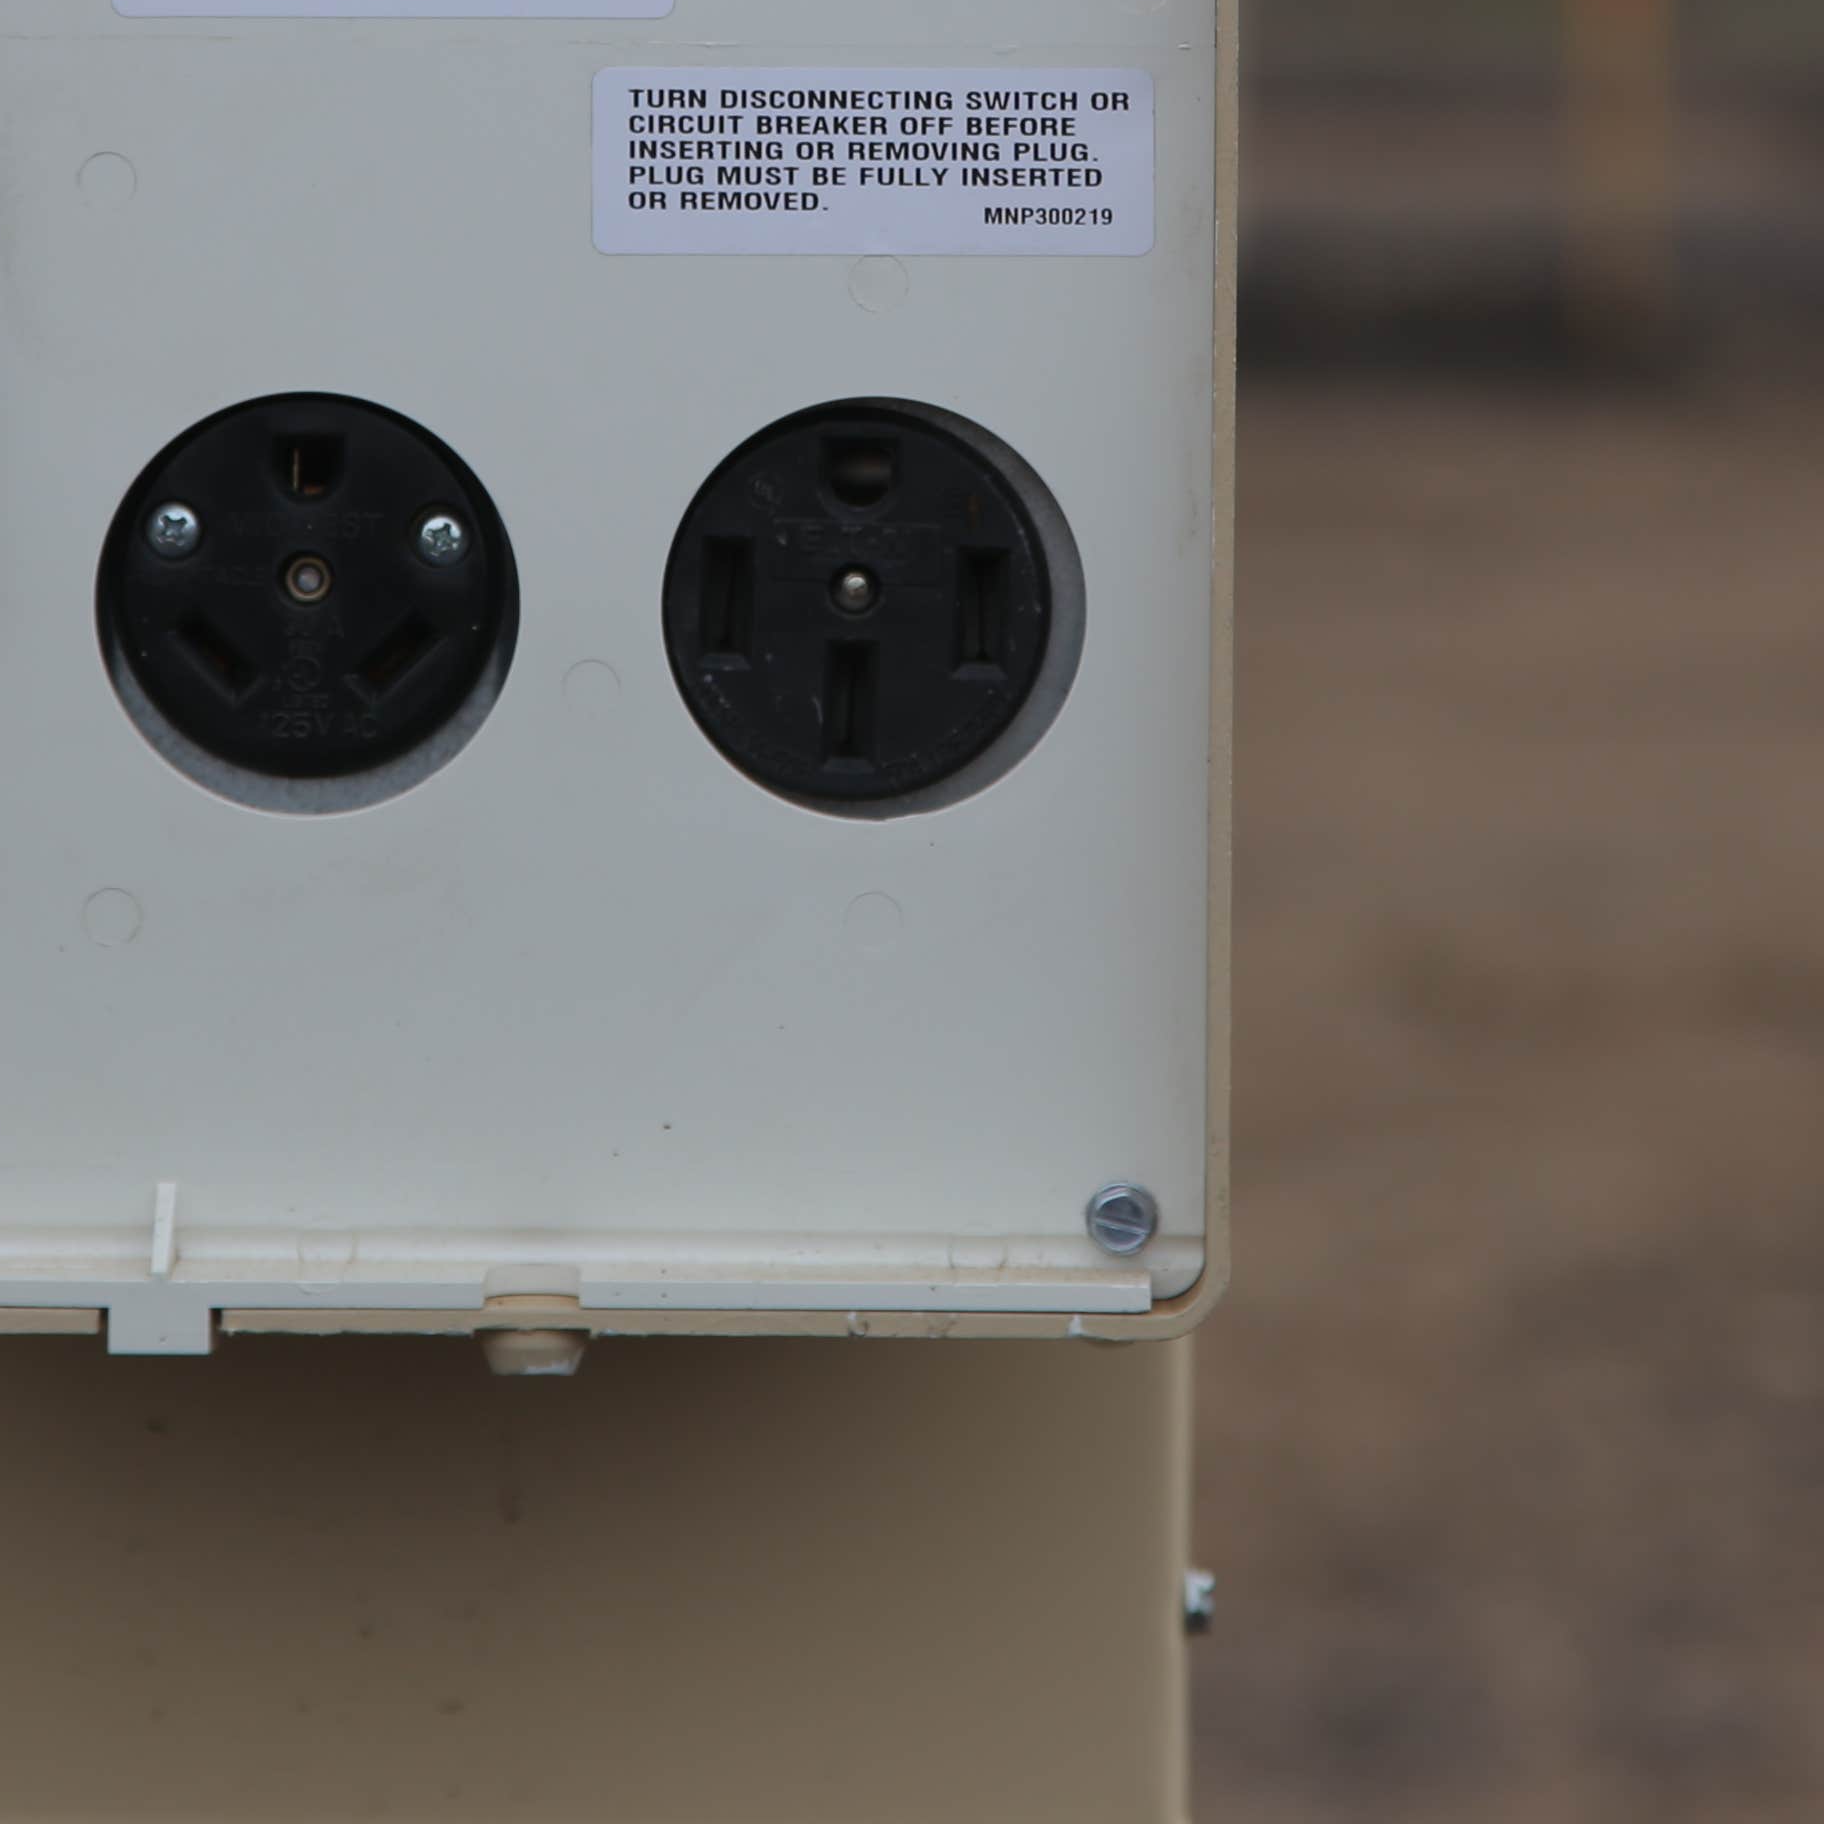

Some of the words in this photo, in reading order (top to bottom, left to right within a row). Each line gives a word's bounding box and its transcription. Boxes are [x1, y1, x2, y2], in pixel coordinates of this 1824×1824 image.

[629, 89, 706, 108] TURN
[721, 90, 952, 110] DISCONNECTING
[966, 91, 1077, 110] SWITCH
[1091, 92, 1128, 110] OR
[629, 115, 743, 134] CIRCUIT
[757, 116, 887, 135] BREAKER
[900, 117, 952, 135] OFF
[967, 117, 1075, 136] BEFORE
[630, 141, 782, 160] INSERTING
[796, 142, 834, 160] OR
[849, 142, 999, 161] REMOVING
[1014, 143, 1097, 161] PLUG.
[630, 166, 703, 184] PLUG
[718, 166, 799, 185] MUST
[813, 167, 846, 185] BE
[860, 167, 948, 186] FULLY
[962, 168, 1102, 187] INSERTED
[629, 192, 666, 209] OR
[681, 192, 828, 210] REMOVED.
[985, 208, 1112, 225] MNP300219
